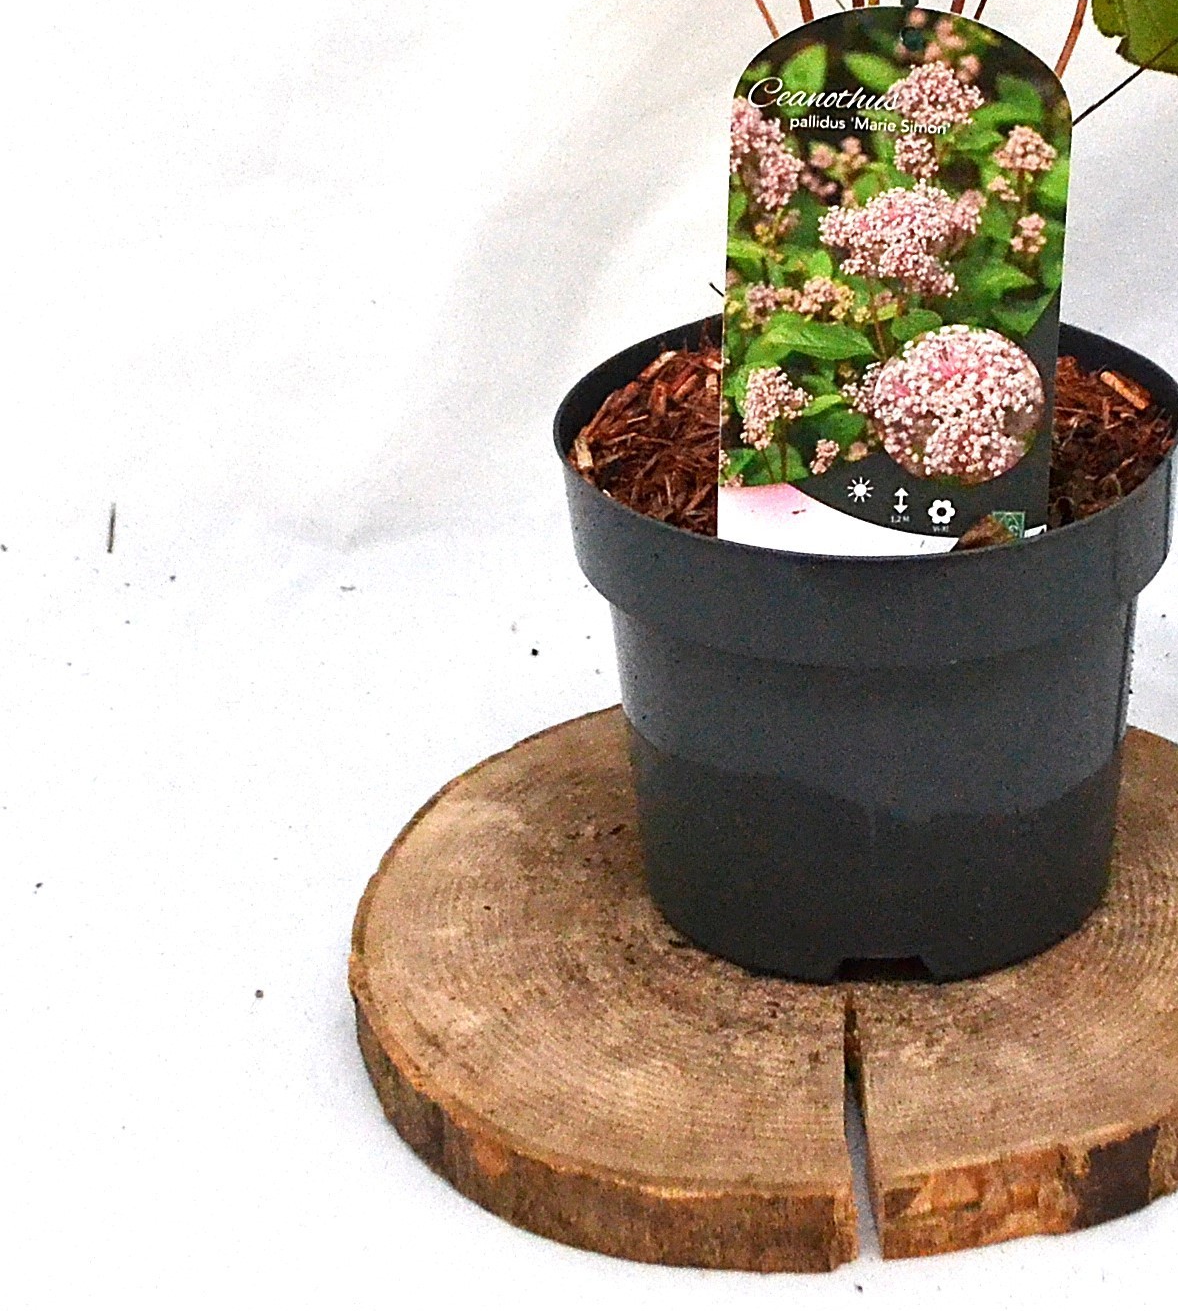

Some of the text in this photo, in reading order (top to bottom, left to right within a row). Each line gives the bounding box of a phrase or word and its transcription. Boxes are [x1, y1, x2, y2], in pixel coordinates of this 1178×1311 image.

[747, 76, 903, 111] Ceanothus
[789, 115, 951, 135] pallidus 'Marie Simon'
